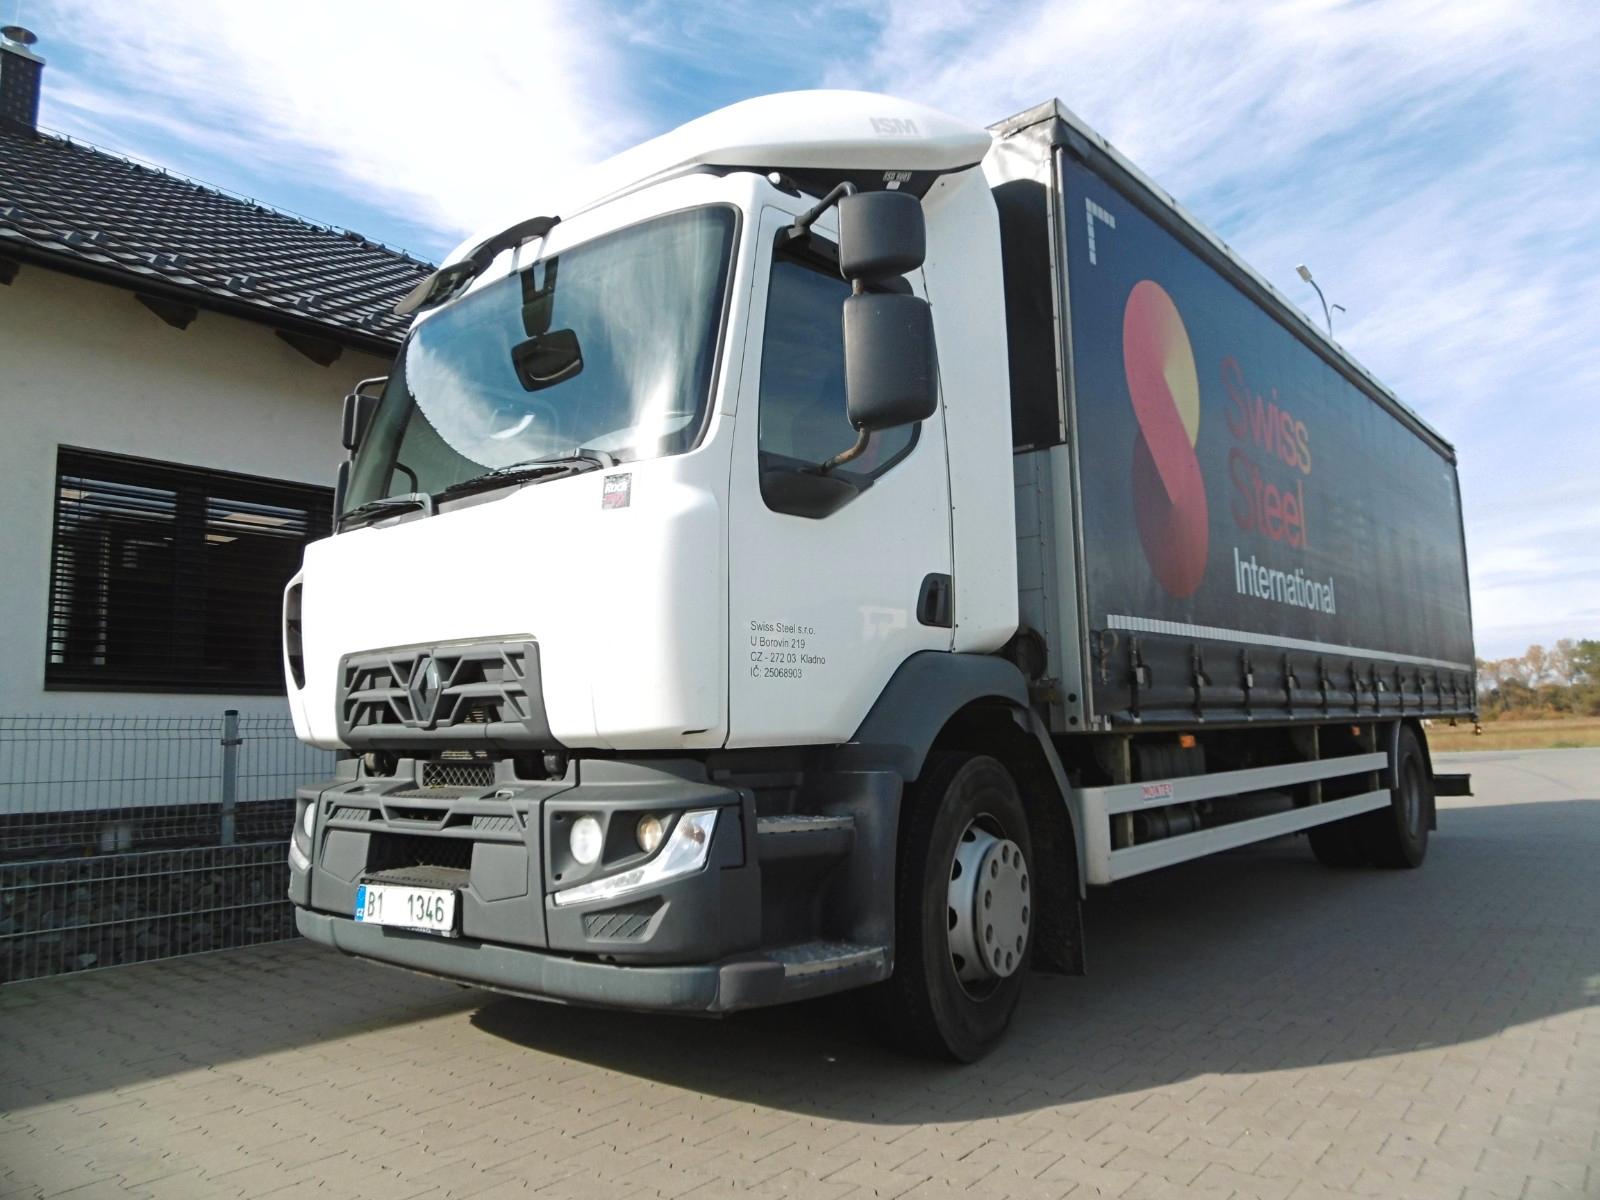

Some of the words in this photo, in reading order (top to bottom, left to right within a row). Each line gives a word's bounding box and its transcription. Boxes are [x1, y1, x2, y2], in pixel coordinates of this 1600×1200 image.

[1221, 354, 1312, 476] Swiss
[1228, 447, 1308, 550] Steel
[1234, 547, 1336, 614] International
[750, 620, 774, 632] Swiss
[776, 622, 796, 634] Steel
[750, 635, 758, 647] U
[759, 636, 789, 648] Borovin
[791, 638, 806, 649] 219
[750, 651, 763, 662] CZ
[770, 652, 785, 663] 272
[786, 653, 797, 664] 03
[800, 653, 826, 665] Kladno
[764, 667, 803, 679] 25068903
[407, 894, 445, 924] 1346
